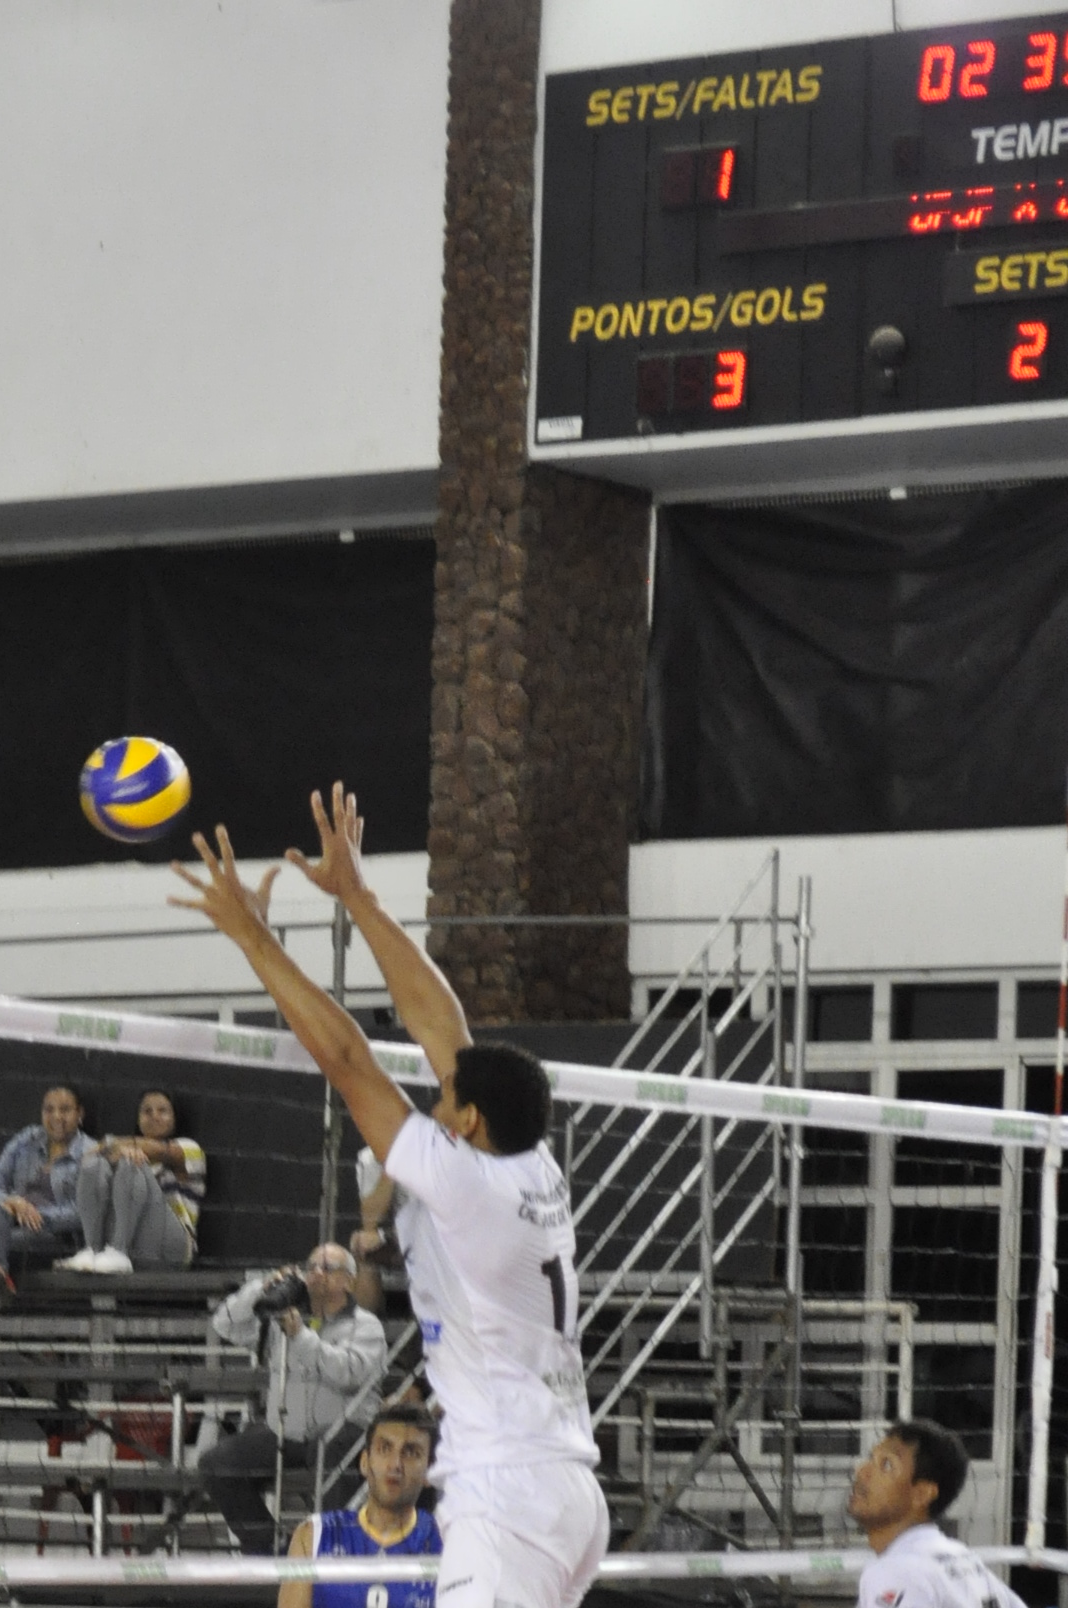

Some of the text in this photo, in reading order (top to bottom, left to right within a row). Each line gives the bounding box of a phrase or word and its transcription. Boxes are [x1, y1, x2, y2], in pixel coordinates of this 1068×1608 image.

[1022, 31, 1068, 91] 3
[586, 65, 823, 127] SETS/FALTAS
[718, 149, 734, 199] 1
[974, 249, 1068, 294] SETS
[570, 284, 827, 342] PONTOS/GOLS
[712, 350, 747, 409] 3
[1009, 321, 1048, 380] 2
